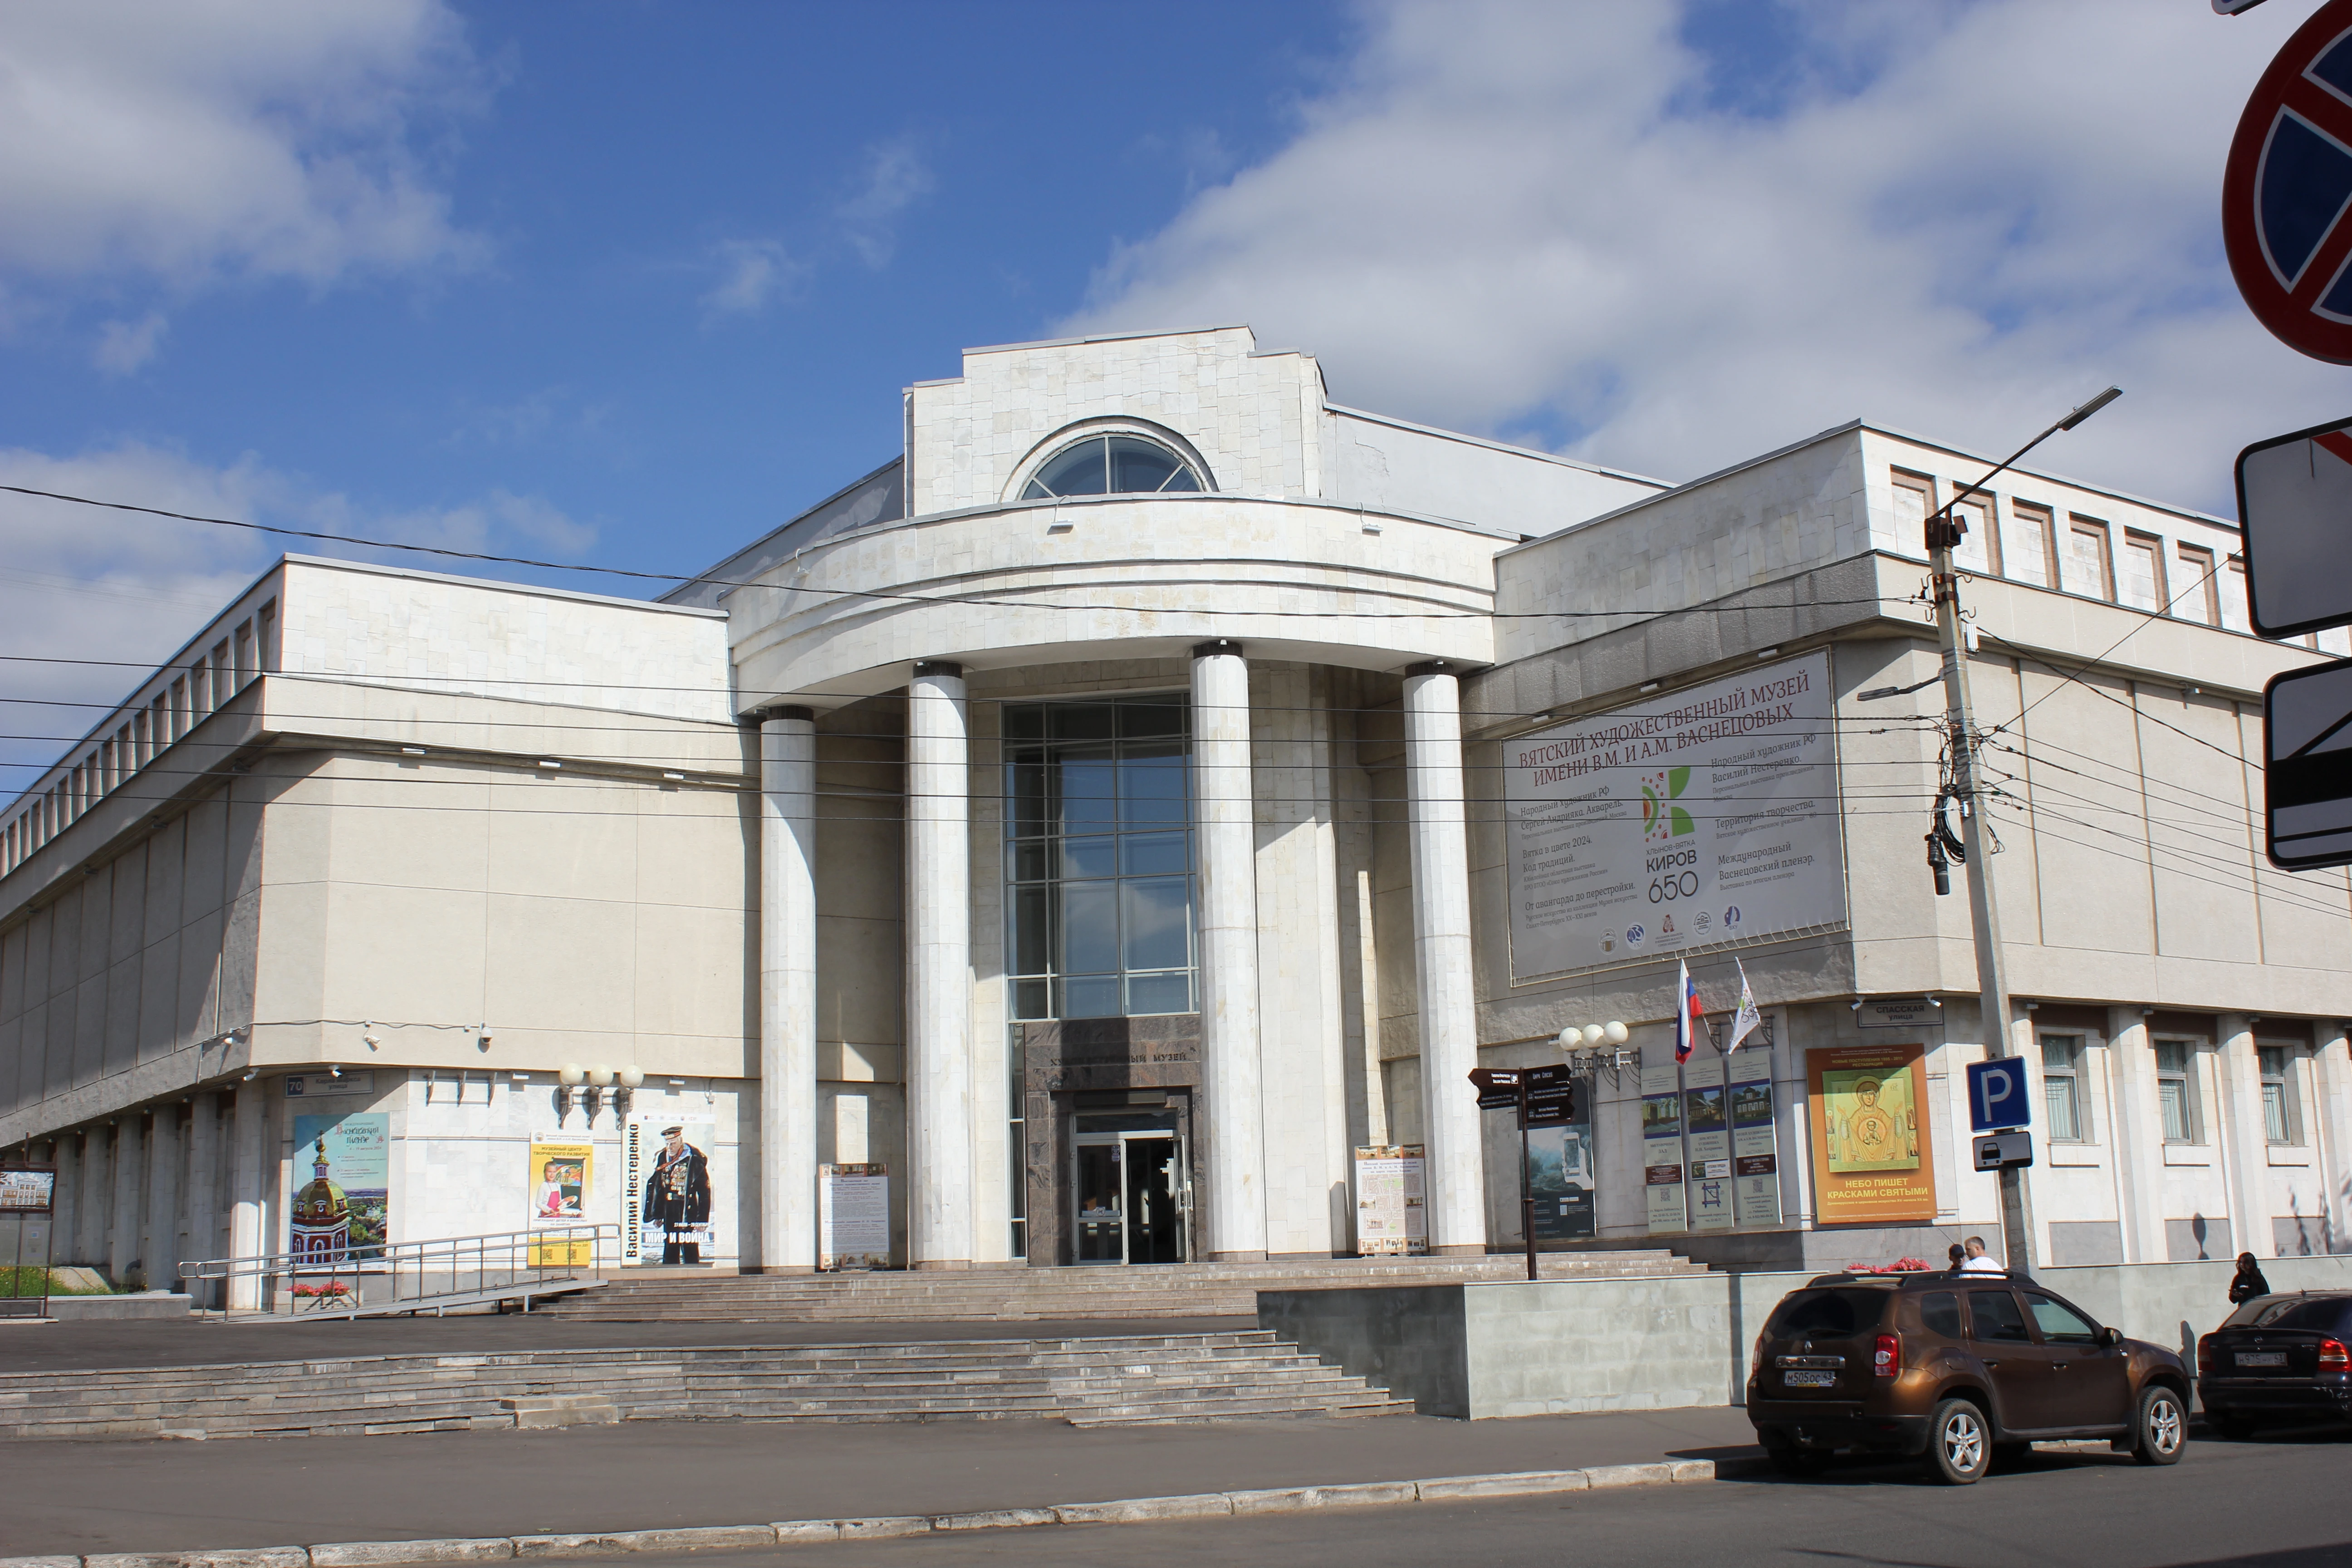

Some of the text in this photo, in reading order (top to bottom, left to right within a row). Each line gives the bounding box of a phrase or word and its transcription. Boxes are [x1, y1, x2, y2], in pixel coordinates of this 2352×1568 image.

[1519, 670, 1810, 769] ВЯТСКИЙ ХУДОЖЕСТВЕННЫЙ МУЗЕЙ
[1533, 702, 1793, 787] ИМЕНИ В.М. И А.М. ВАСНЕЦОВЫХ
[1711, 734, 1816, 768] Народный художник РФ
[1712, 755, 1801, 783] Василий Нестеренко.
[1521, 786, 1609, 816] Народный художник РФ
[1521, 799, 1623, 831] Сергей Андрияка. Акварель.
[1715, 800, 1816, 830] Территория творчества.
[1523, 848, 1543, 858] Вятка
[1551, 842, 1570, 853] цвете
[1572, 835, 1592, 847] 2024.
[1718, 841, 1791, 865] Международный
[1523, 854, 1575, 872] Код традиций.
[1646, 849, 1697, 873] КИРОВ
[1719, 855, 1814, 880] Васнецовский пленэр.
[1525, 882, 1636, 911] От авангарда до перестройки.
[1649, 871, 1699, 904] 650
[1877, 1005, 1925, 1013] СПАССКАЯ
[1153, 1052, 1187, 1062] МУЗЕЙ
[289, 1082, 302, 1091] 70
[626, 1124, 639, 1258] Василий Нестеренко
[1828, 1187, 1928, 1199] КРАСКАМИ СВЯТЫМИ
[1874, 1178, 1908, 1186] ПИШЕТ
[645, 1230, 710, 1243] МИР И ВОЙНА
